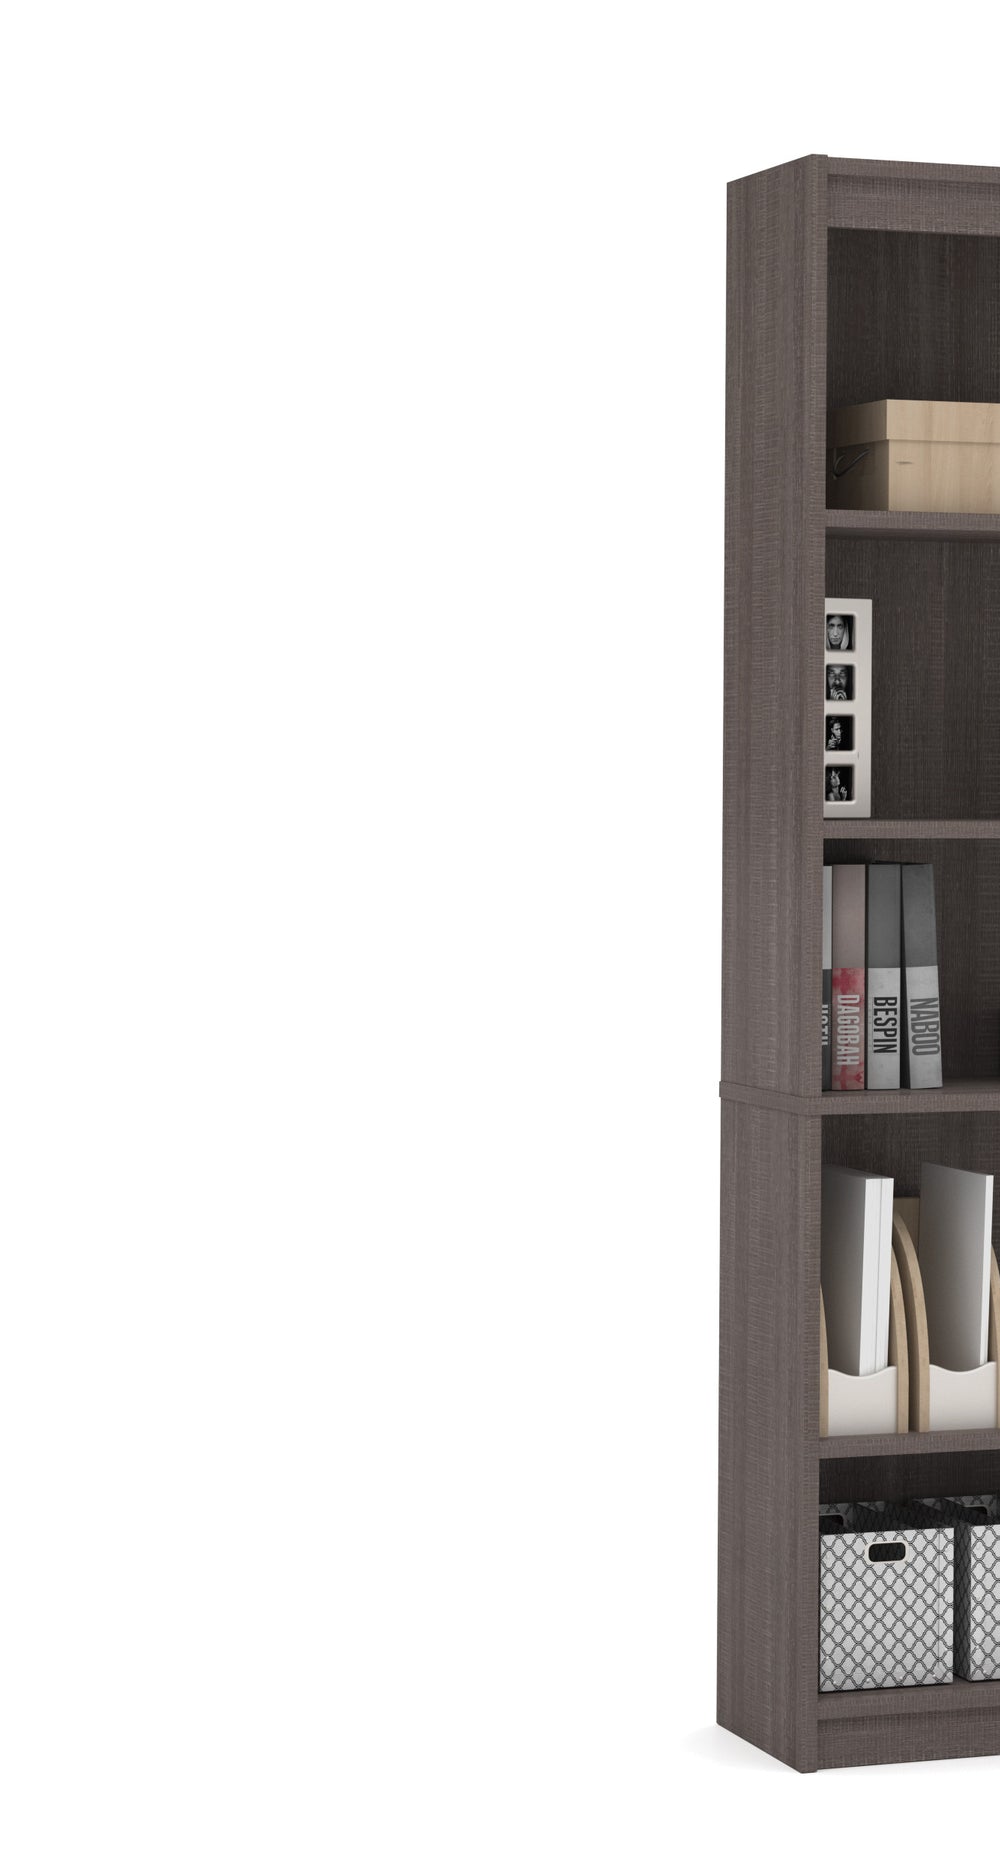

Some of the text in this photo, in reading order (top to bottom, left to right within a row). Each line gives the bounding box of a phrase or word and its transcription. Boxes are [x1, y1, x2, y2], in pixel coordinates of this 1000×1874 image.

[837, 994, 860, 1066] DAGOBAH
[873, 996, 898, 1054] BESPIN
[910, 997, 940, 1056] NABOO
